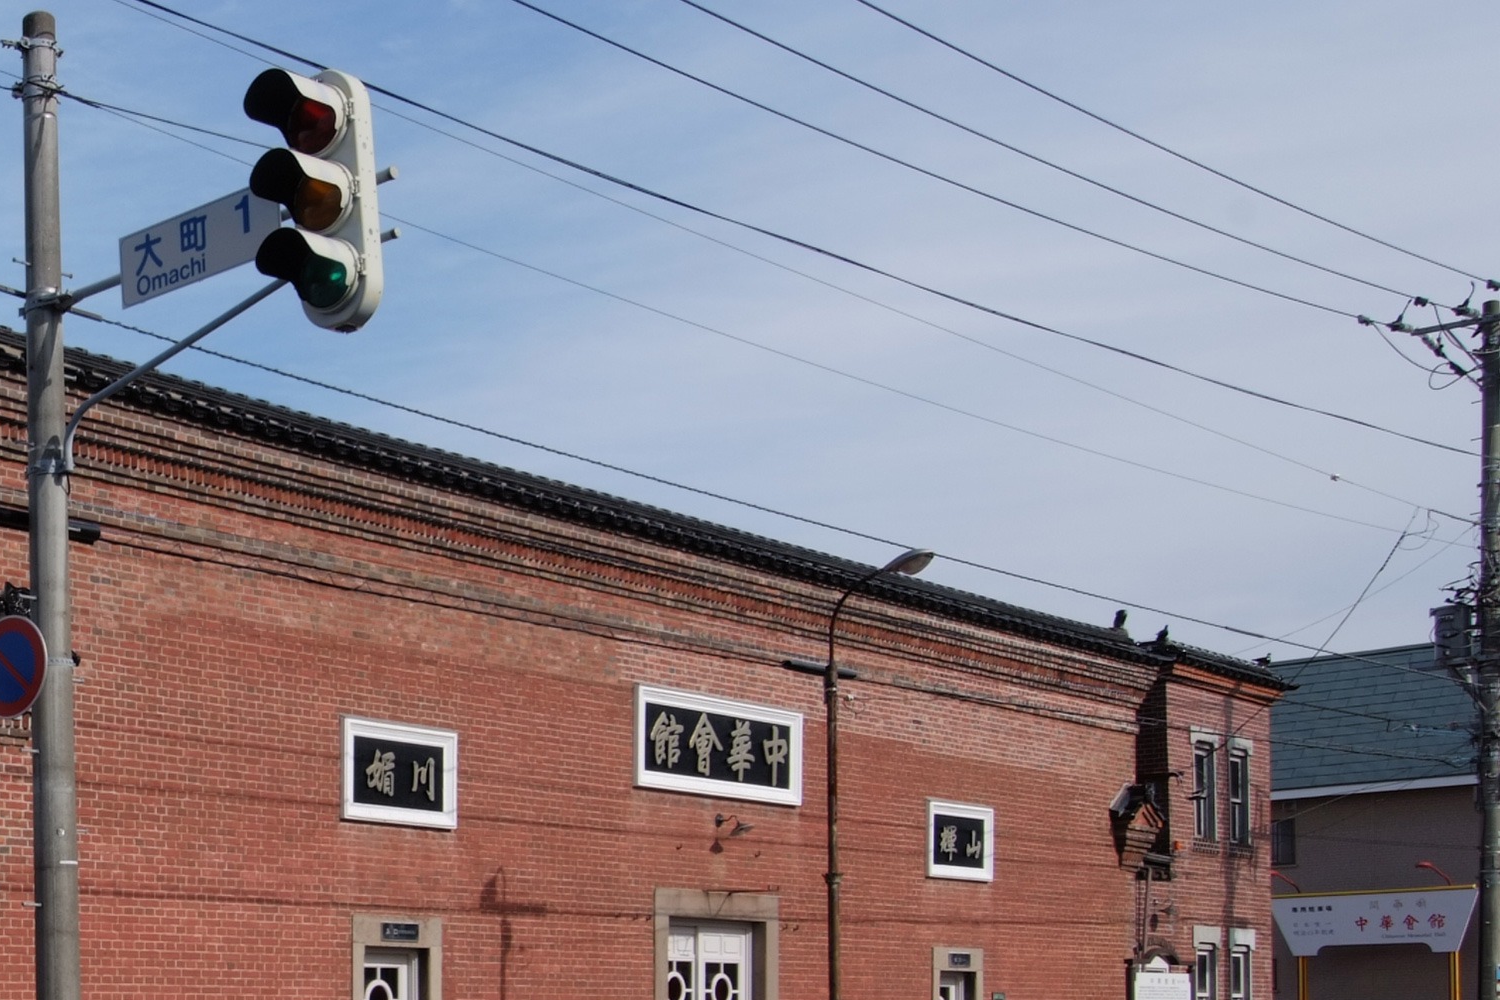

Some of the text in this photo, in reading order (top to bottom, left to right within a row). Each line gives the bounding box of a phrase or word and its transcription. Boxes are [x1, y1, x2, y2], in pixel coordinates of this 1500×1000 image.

[134, 194, 251, 276] 大町 1
[136, 253, 207, 296] Omachi
[650, 710, 789, 788] 中華會館
